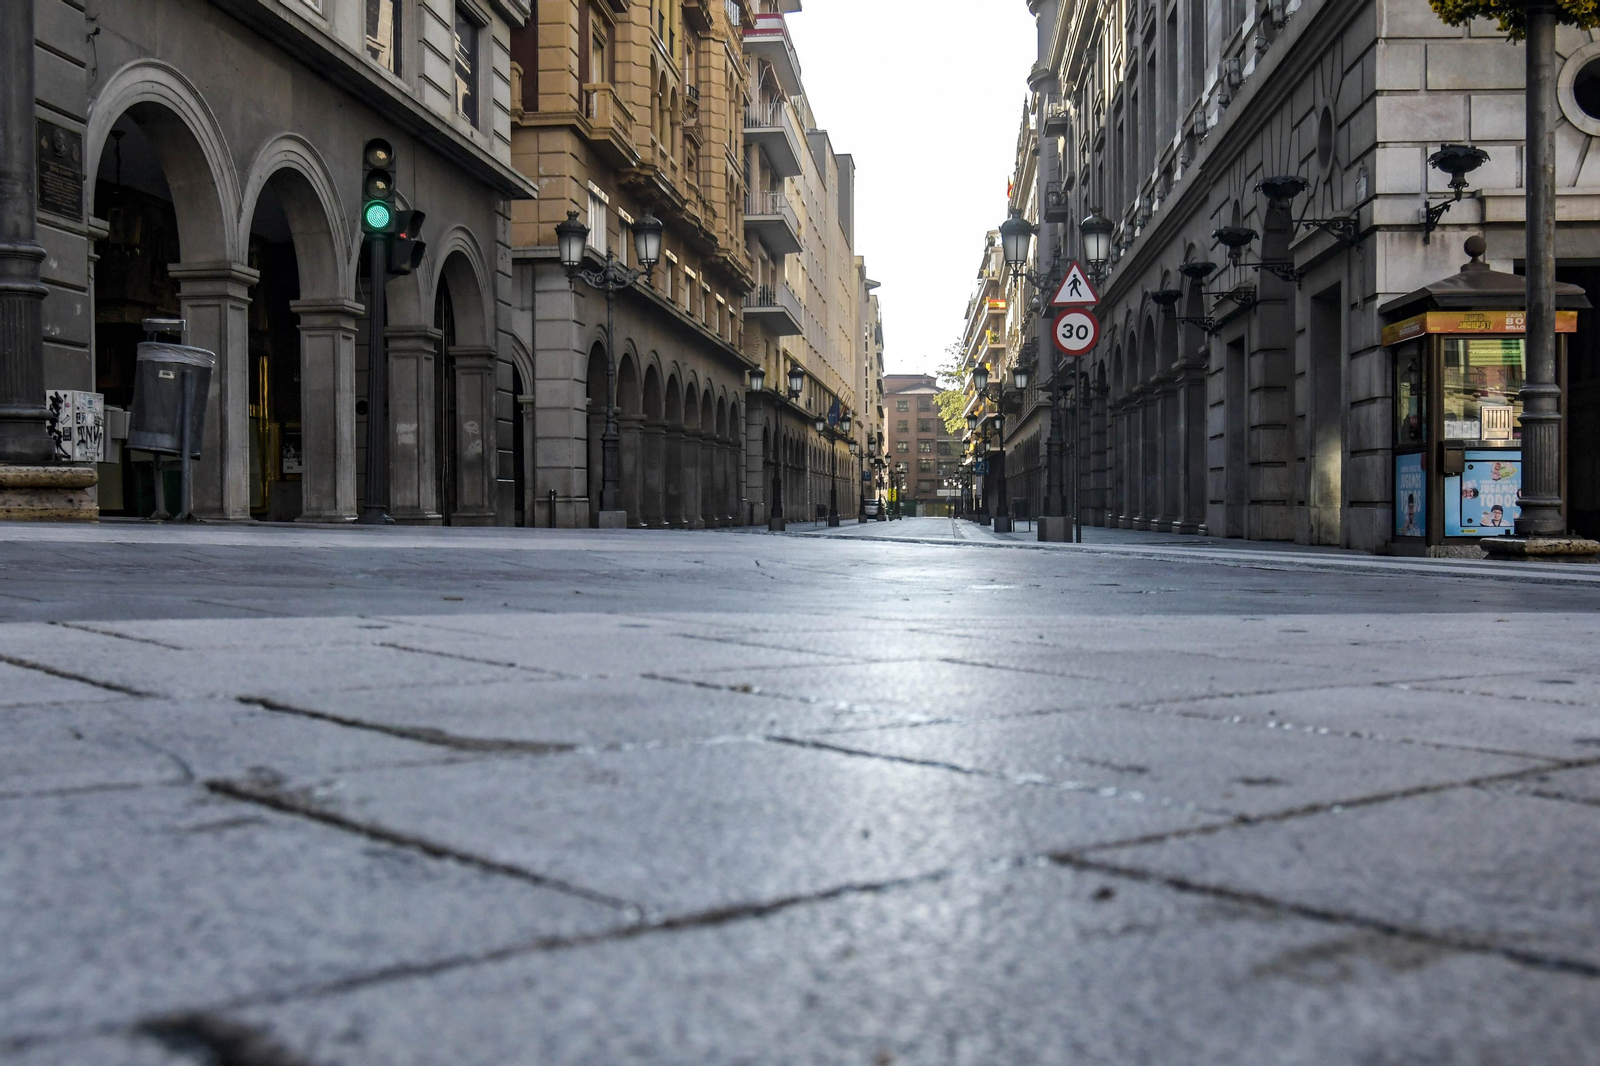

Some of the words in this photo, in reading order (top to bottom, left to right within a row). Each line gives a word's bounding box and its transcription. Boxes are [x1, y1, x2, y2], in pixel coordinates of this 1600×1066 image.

[1062, 323, 1089, 340] 30
[1458, 321, 1491, 330] JACKPOT
[1480, 484, 1517, 494] JUGAMOS
[1480, 493, 1517, 508] TODOS
